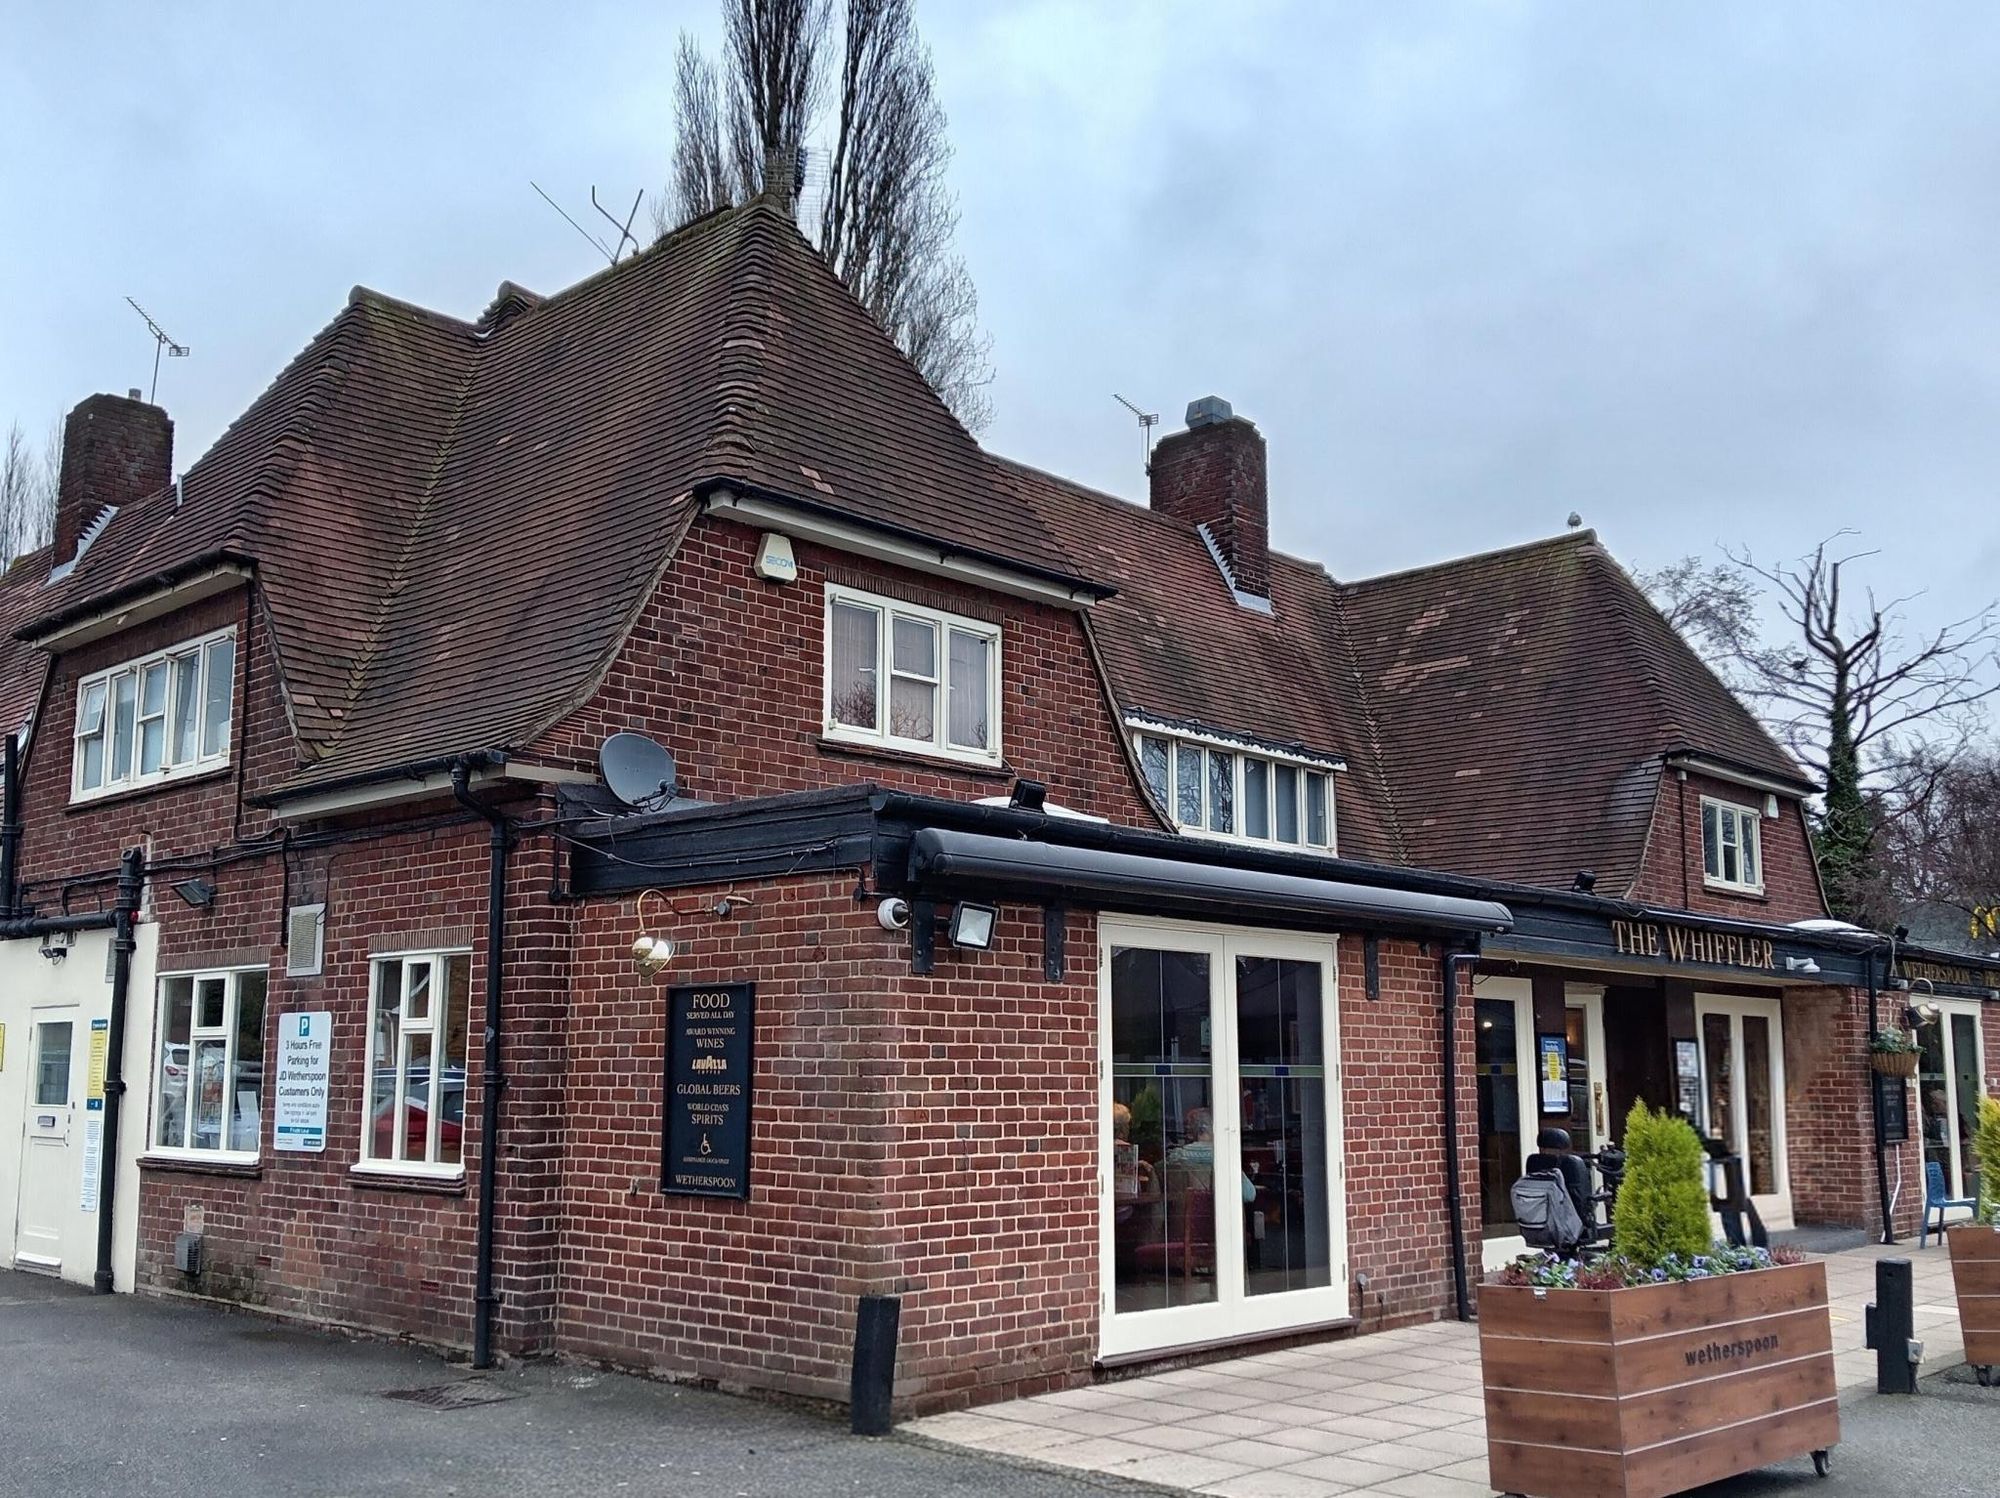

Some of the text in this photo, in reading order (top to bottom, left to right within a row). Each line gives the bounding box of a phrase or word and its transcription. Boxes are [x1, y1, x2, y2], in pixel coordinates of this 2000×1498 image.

[1612, 920, 1775, 970] THE WHIFFLER
[693, 993, 730, 1009] FOOD
[686, 1010, 735, 1020] SERVED ALL DAY
[707, 1027, 736, 1035] WINNING
[291, 1041, 308, 1050] Hours
[309, 1040, 322, 1050] Free
[696, 1038, 725, 1048] WINES
[287, 1055, 319, 1067] Parking for
[279, 1070, 326, 1082] JD Wetherspoon
[279, 1086, 325, 1099] Customers Only
[677, 1083, 741, 1096] GLOBAL BEERS
[687, 1102, 730, 1112] WORLD CLASS
[691, 1114, 724, 1125] SPIRITS
[675, 1174, 737, 1188] WETHERSPOON
[1685, 1334, 1778, 1366] wetherspoon
